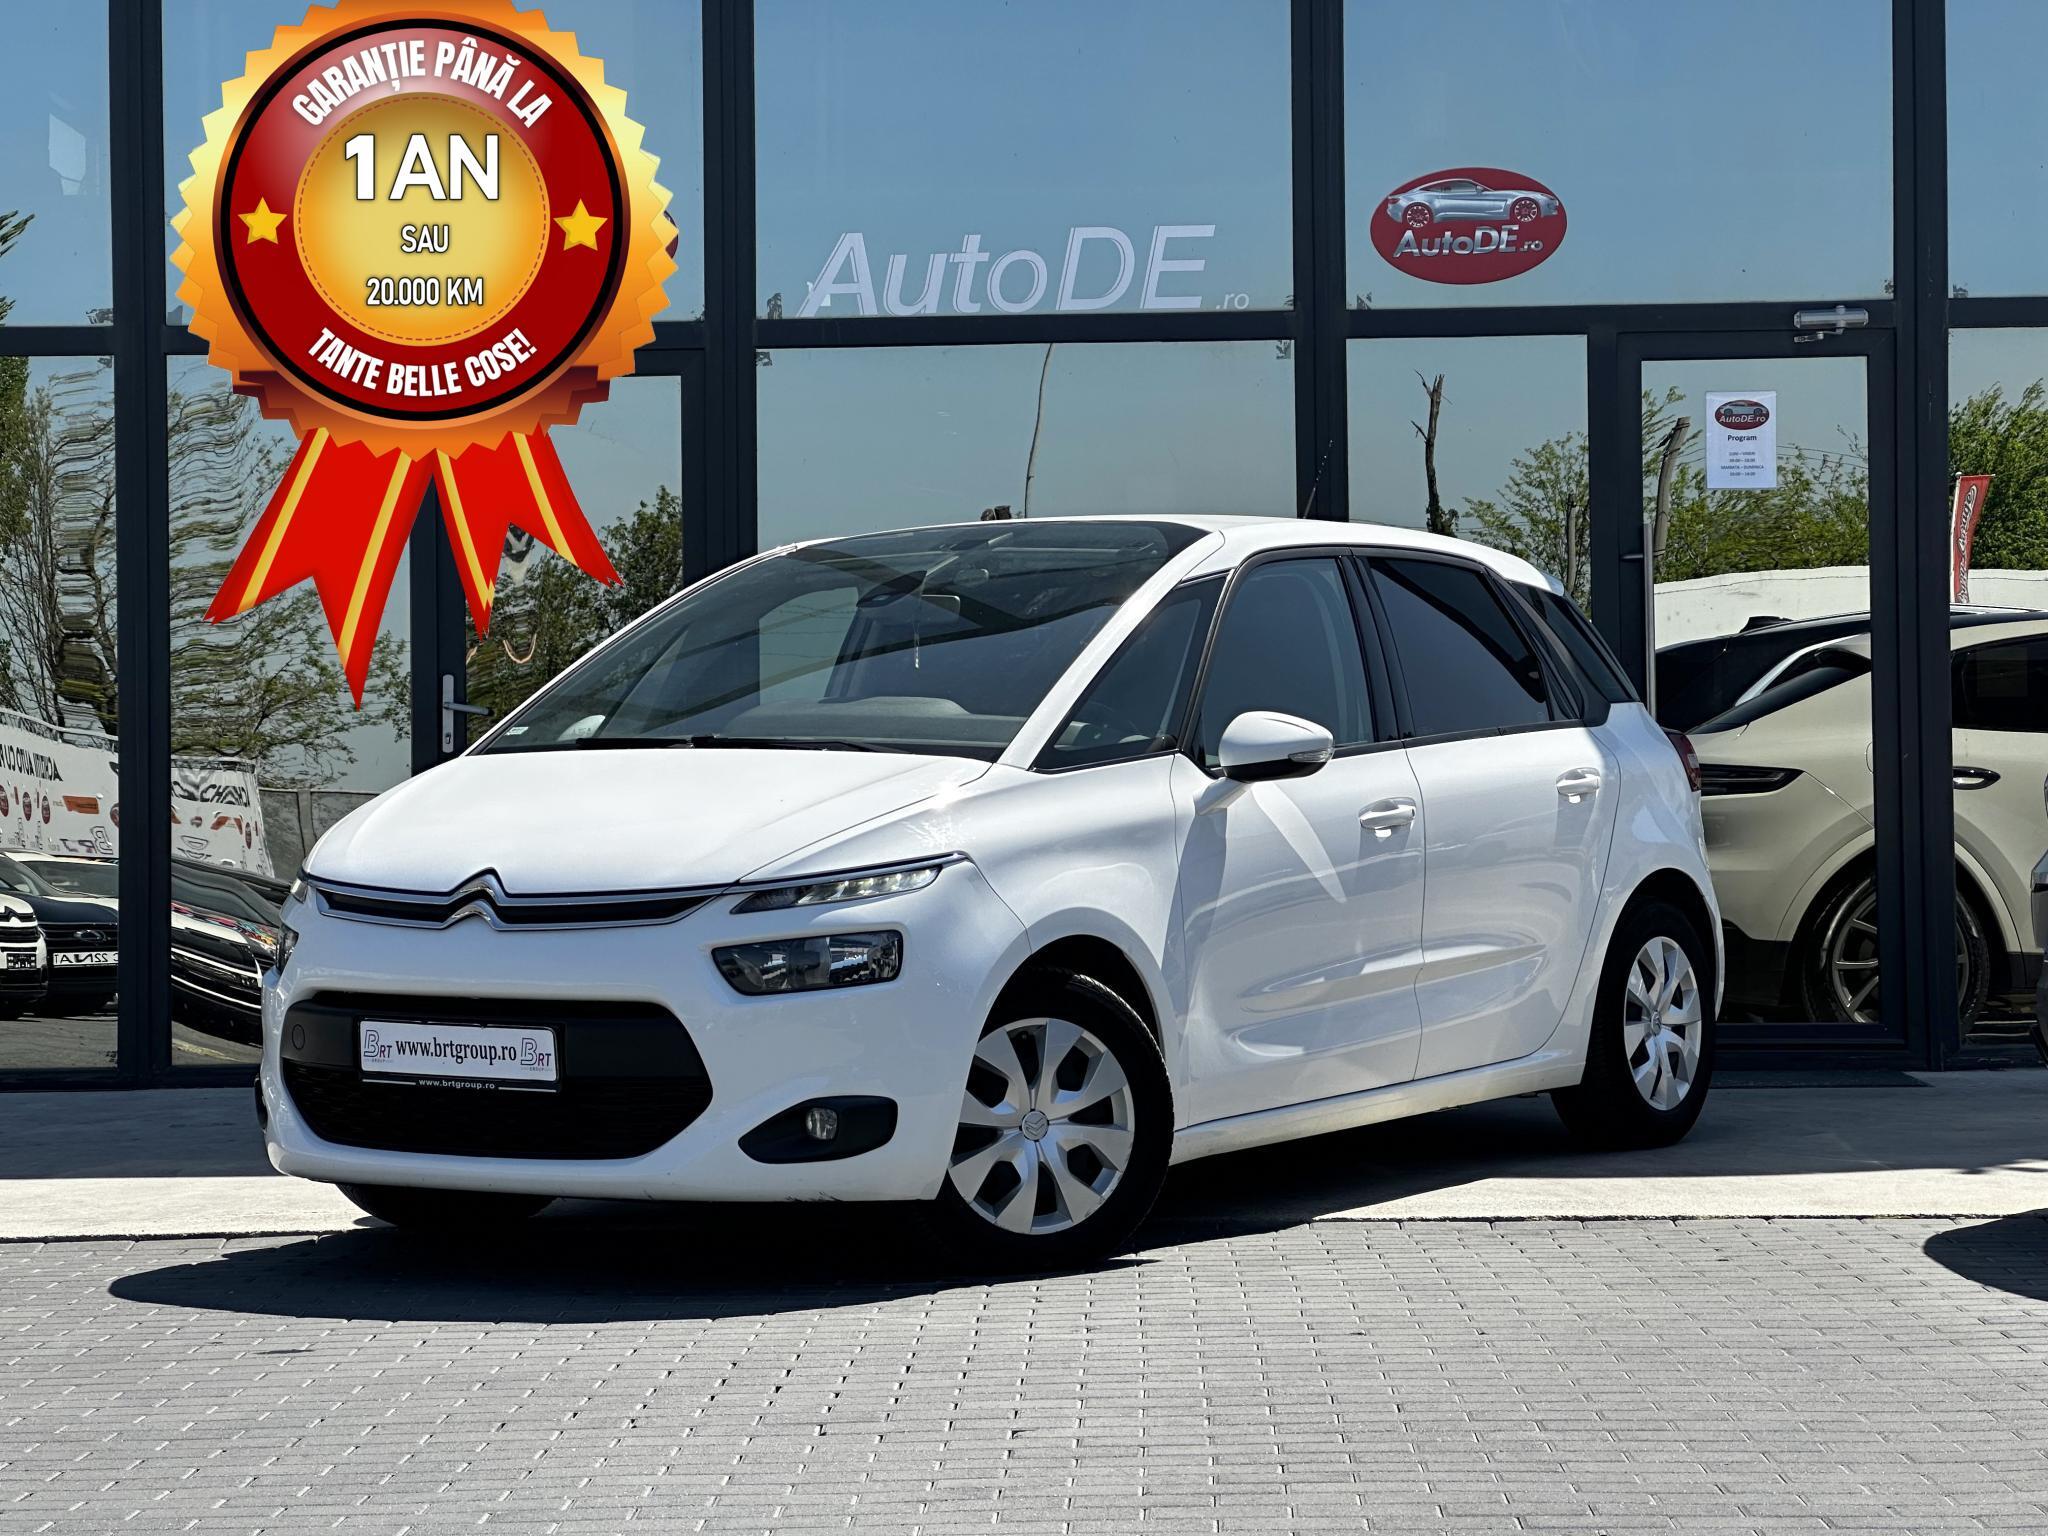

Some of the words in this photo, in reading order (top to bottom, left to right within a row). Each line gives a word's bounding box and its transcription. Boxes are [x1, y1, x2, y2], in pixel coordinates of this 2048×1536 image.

[1727, 434, 1757, 442] Program
[396, 1037, 517, 1064] www.brtgroup.ro
[418, 1078, 495, 1090] www.brtgroup.ro
